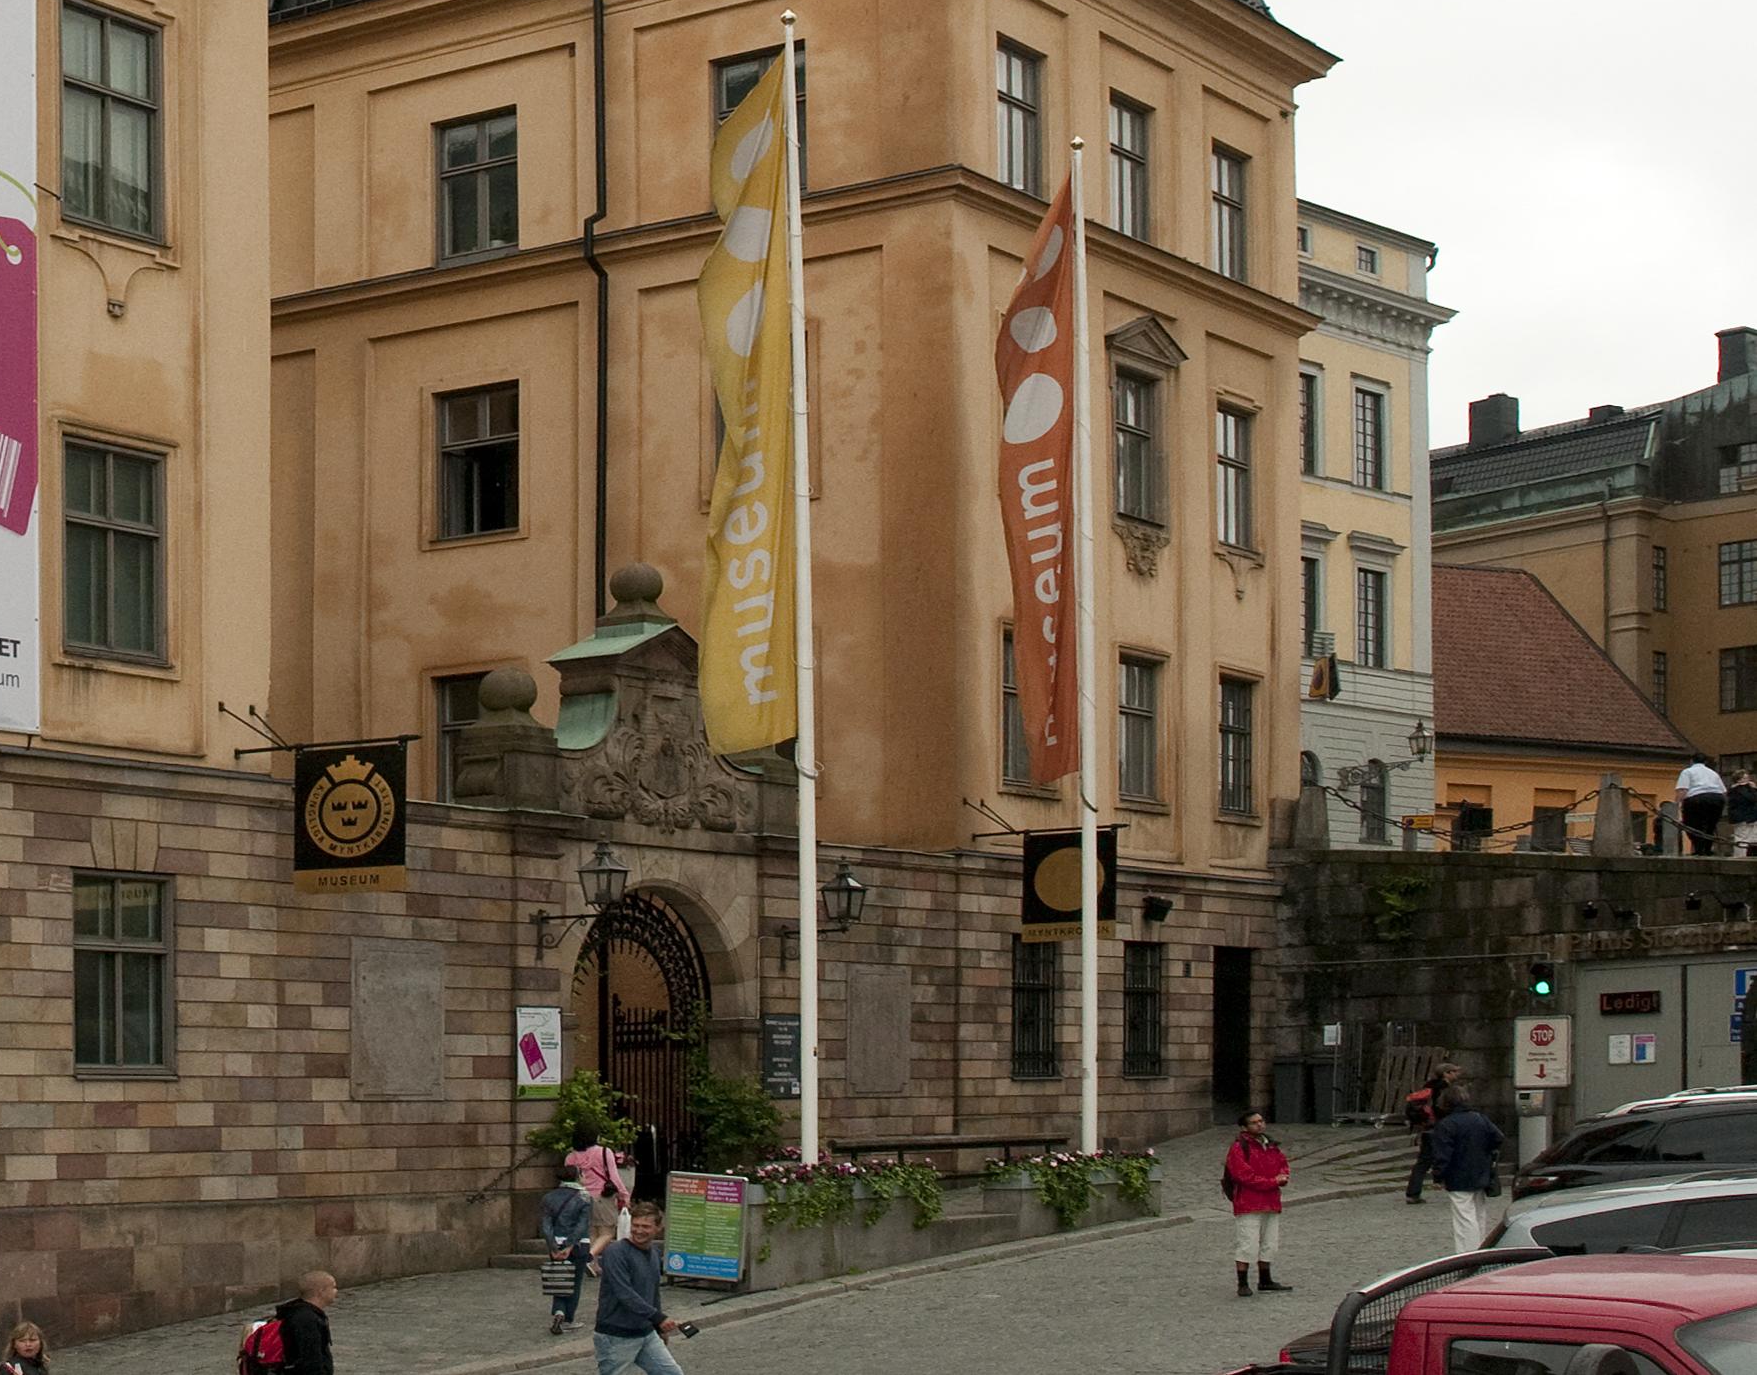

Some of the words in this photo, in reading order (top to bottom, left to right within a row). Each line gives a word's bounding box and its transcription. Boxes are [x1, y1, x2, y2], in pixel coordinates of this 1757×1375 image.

[308, 784, 325, 844] KUNGLIGA
[328, 780, 392, 855] MYNTKABINETTET
[318, 874, 380, 886] MUSEUM
[1602, 994, 1658, 1011] Ledigt
[1532, 1029, 1554, 1041] STOP
